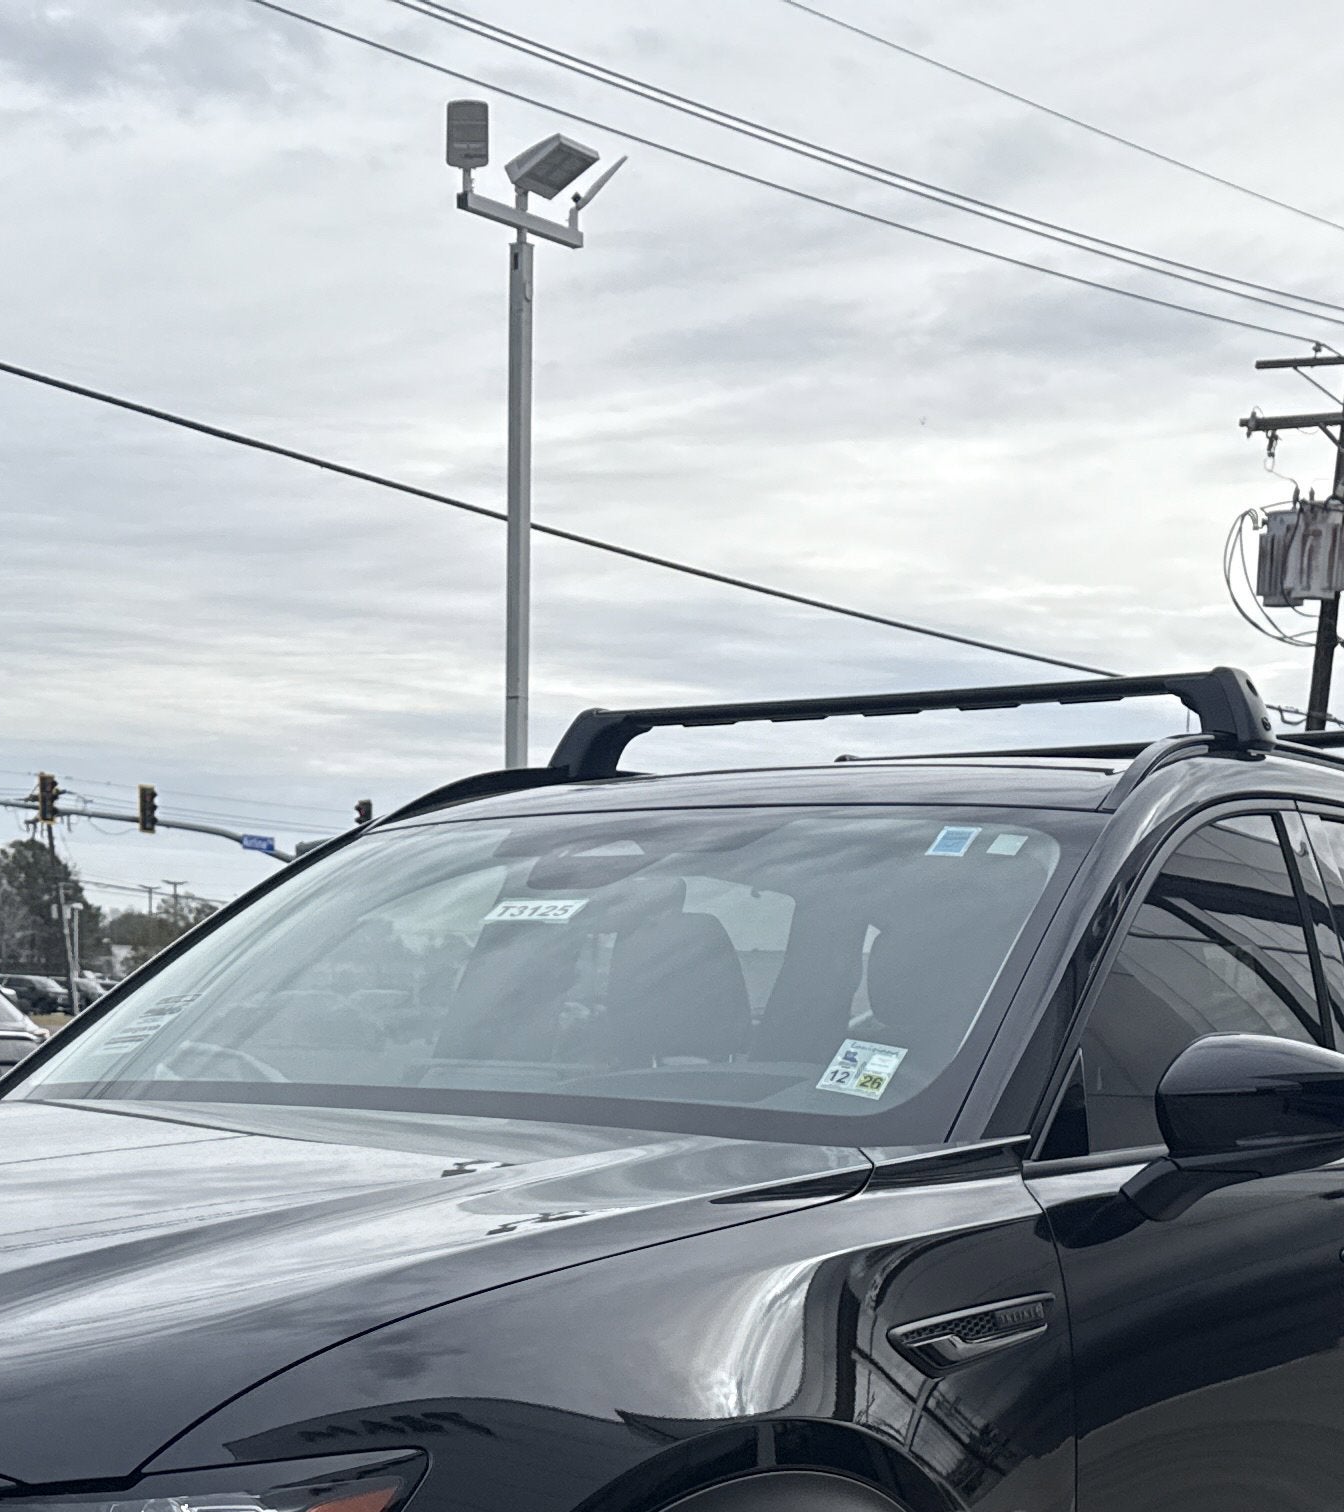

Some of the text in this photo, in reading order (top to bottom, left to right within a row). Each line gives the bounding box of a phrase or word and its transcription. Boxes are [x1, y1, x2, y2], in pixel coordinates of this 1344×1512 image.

[497, 905, 573, 917] T3125
[829, 1069, 851, 1084] 12
[859, 1075, 883, 1090] 26
